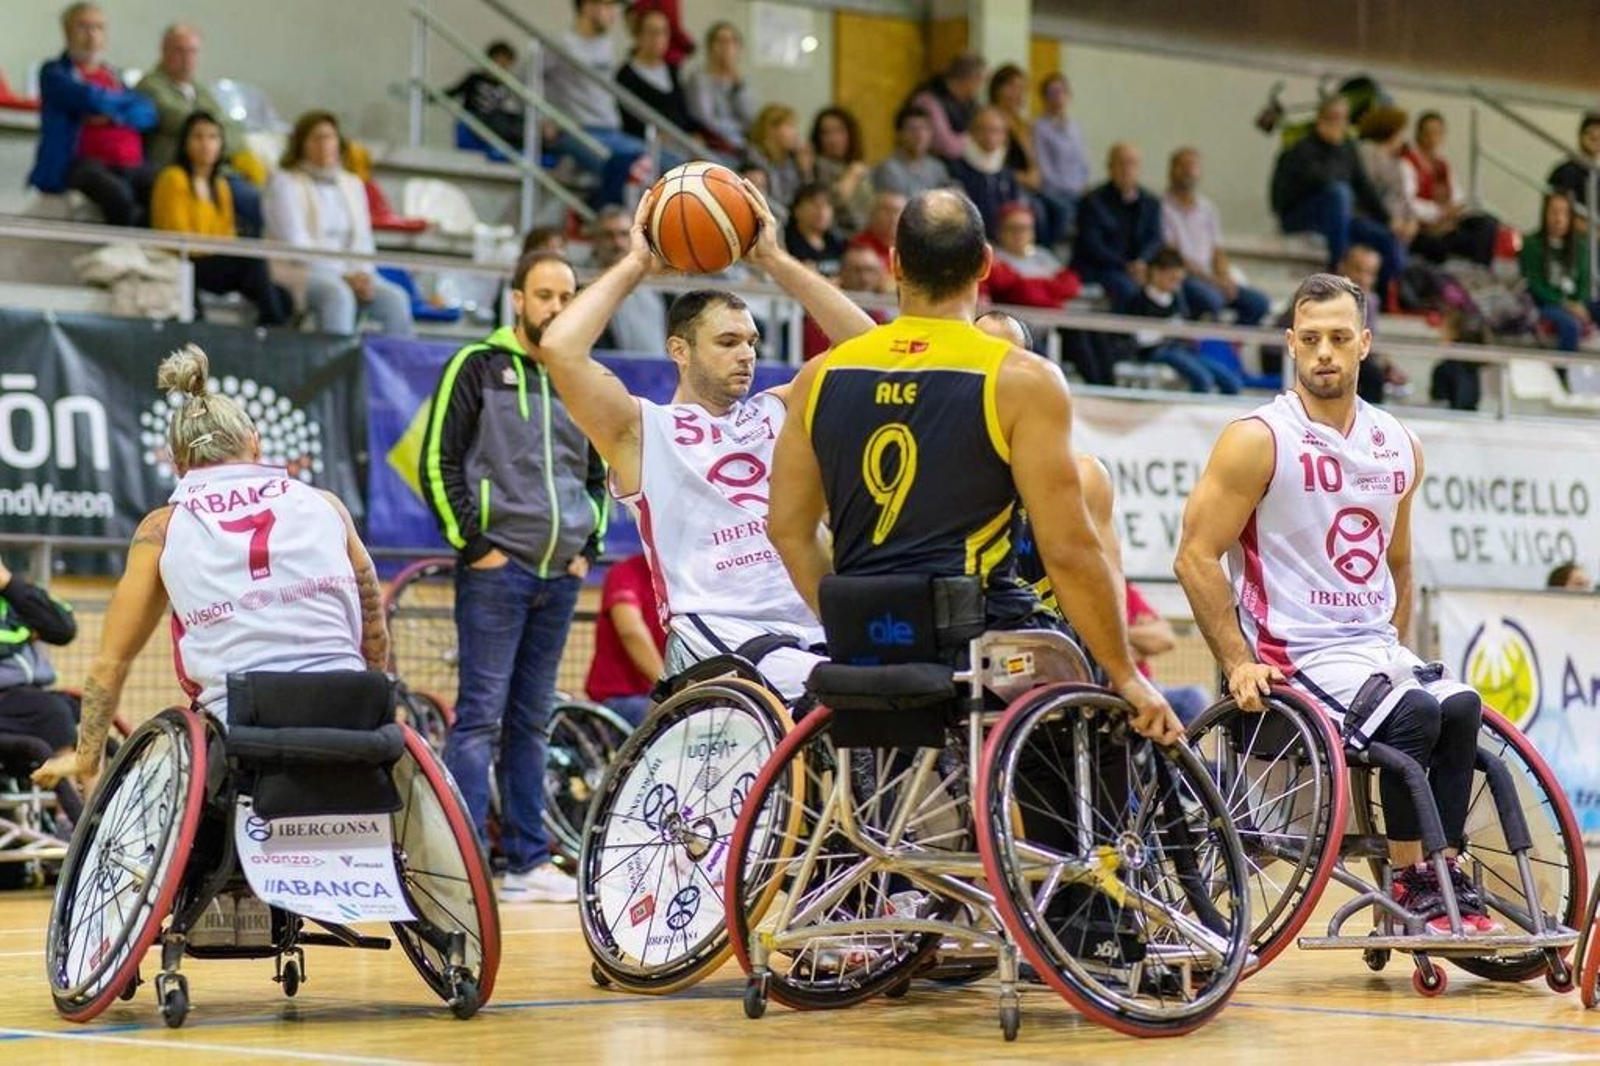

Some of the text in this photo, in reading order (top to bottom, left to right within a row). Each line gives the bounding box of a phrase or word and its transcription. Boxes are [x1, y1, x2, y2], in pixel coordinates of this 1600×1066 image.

[875, 381, 917, 405] ALE
[862, 422, 917, 545] 9
[1299, 452, 1343, 493] 10
[1423, 475, 1589, 517] CONCELLO
[218, 508, 276, 581] 7
[716, 550, 772, 571] avanza
[1451, 525, 1577, 566] DE VIGO
[869, 611, 915, 645] ale
[279, 821, 380, 837] IBERCONSA
[251, 855, 311, 865] avanza
